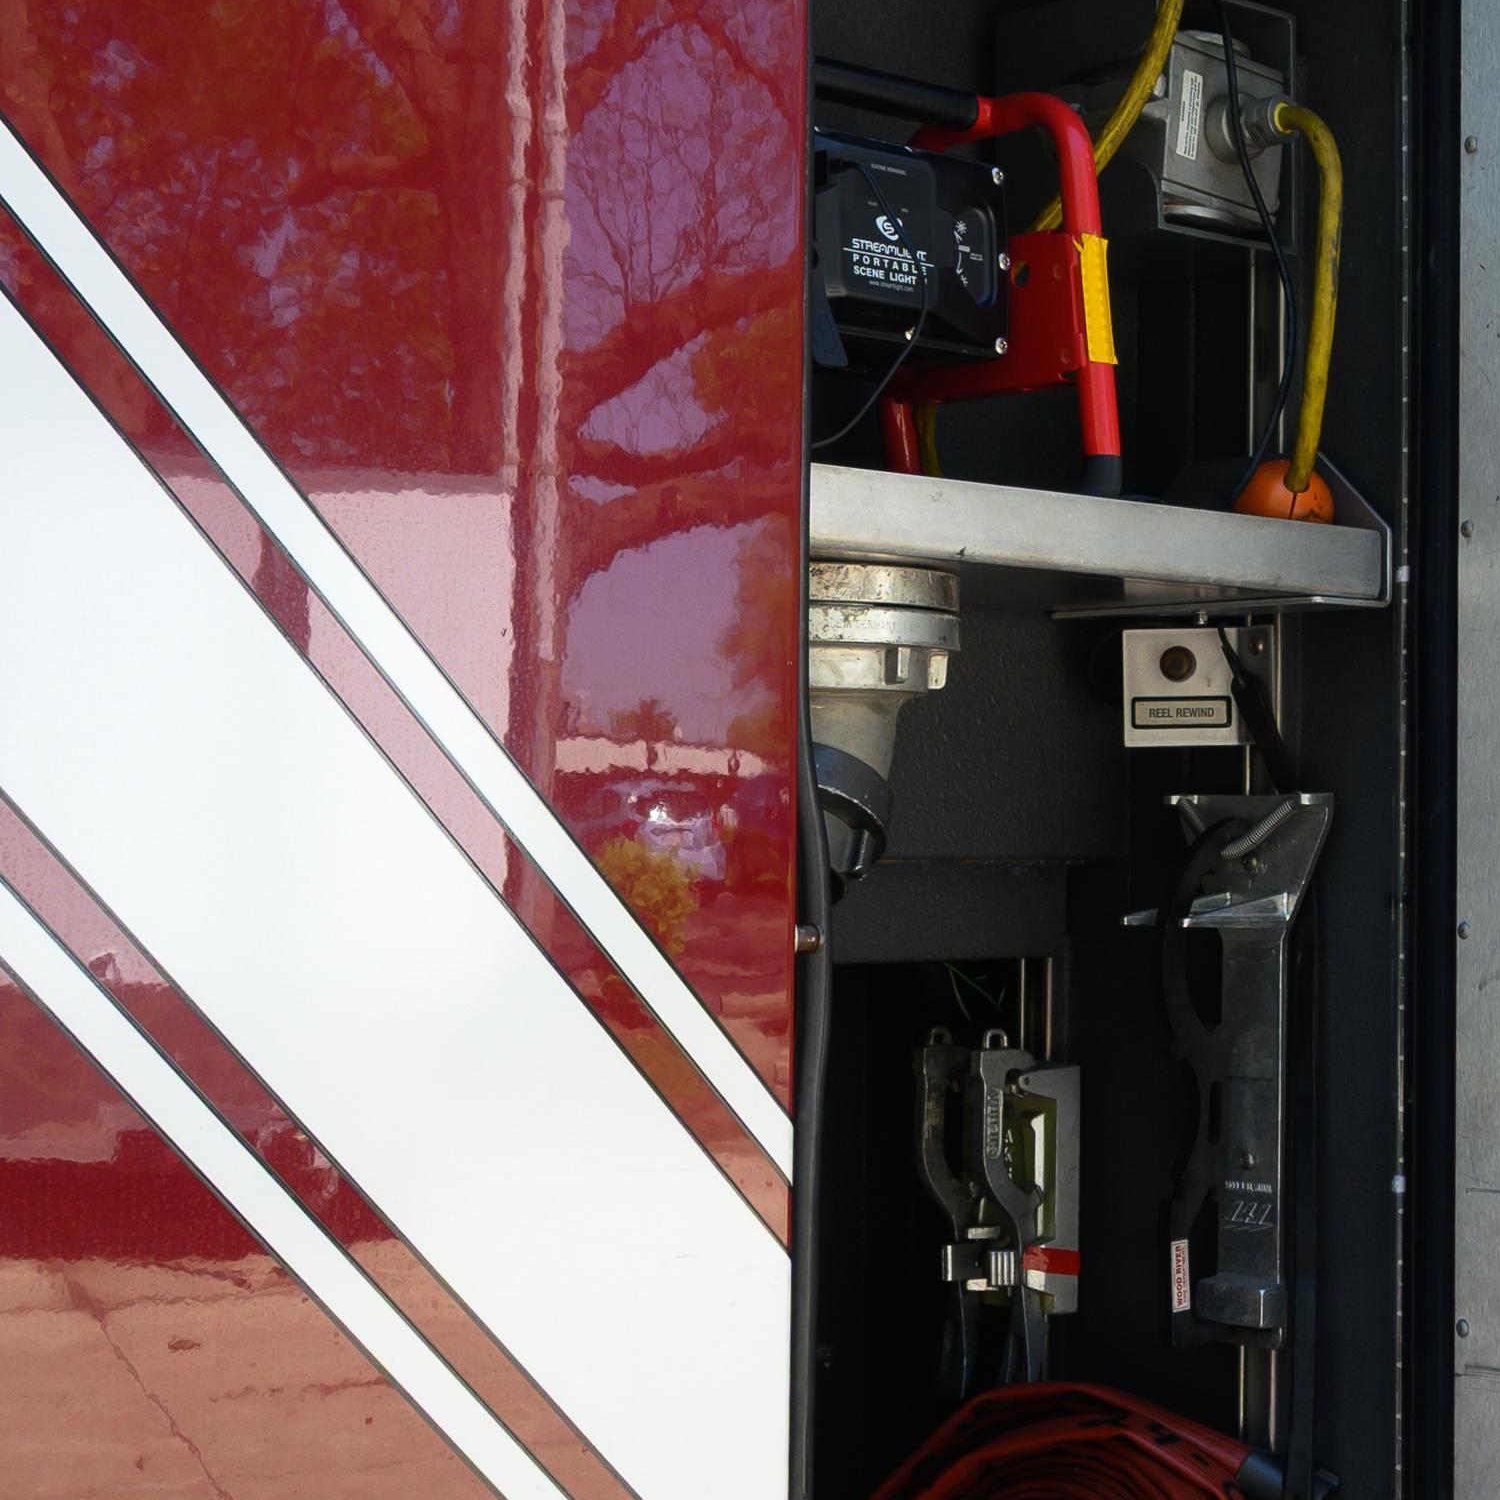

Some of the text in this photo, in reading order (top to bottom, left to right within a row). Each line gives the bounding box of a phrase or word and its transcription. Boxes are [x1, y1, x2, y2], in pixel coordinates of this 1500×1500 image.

[853, 265, 885, 280] SCENE
[889, 272, 917, 285] LIGHT
[1148, 707, 1215, 718] REEL REWIND
